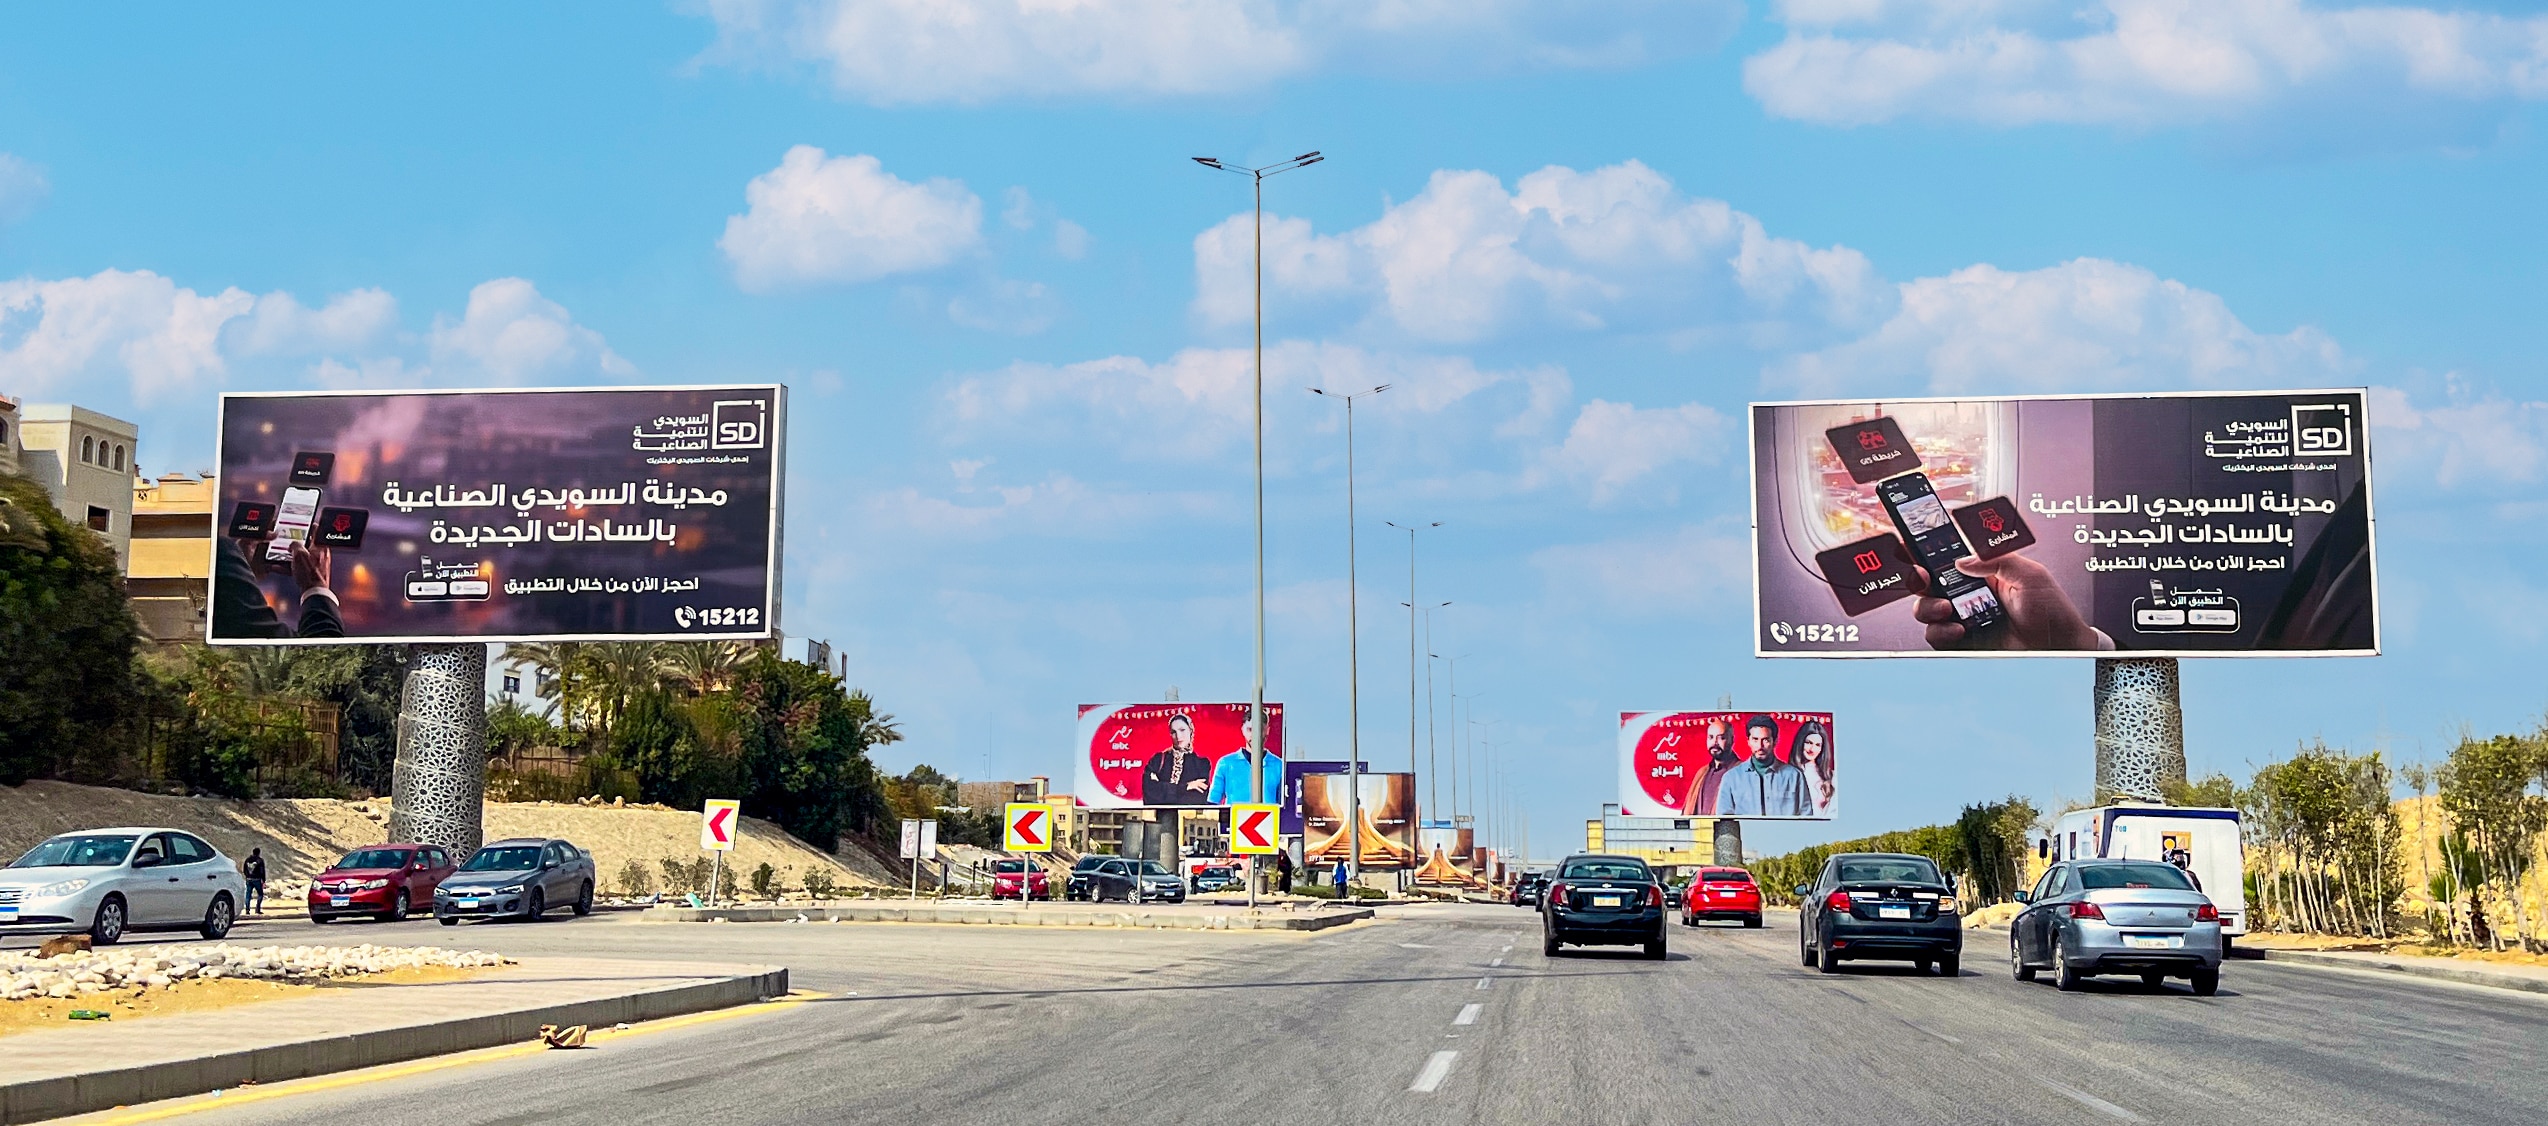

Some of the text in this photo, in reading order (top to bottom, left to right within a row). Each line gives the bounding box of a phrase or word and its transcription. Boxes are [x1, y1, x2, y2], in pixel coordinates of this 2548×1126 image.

[653, 413, 709, 430] السويدي
[2225, 418, 2288, 436] السويدي
[633, 425, 709, 439] للتنمية
[720, 422, 757, 442] SD
[2205, 431, 2289, 446] للتنمية
[2301, 427, 2344, 449] SD
[632, 438, 708, 452] الصناعية
[2205, 445, 2290, 459] الصناعية
[1872, 450, 1902, 462] خريطة
[382, 478, 728, 517] مدينة السويدي الصناعية
[2029, 489, 2336, 523] مدينة السويدي الصناعية
[430, 518, 677, 548] بالسادات الجديدة
[1988, 530, 2019, 548] المشاريع
[2073, 523, 2294, 549] بالسادات الجديدة
[2085, 554, 2285, 572] احجز الآن من خلال التطبيق
[504, 576, 699, 595] احجز الآن من خلال التطبيق
[1879, 573, 1902, 590] احجز
[2188, 596, 2224, 607] التطبيق
[698, 607, 760, 626] 15212
[1796, 623, 1860, 642] 15212
[1099, 757, 1143, 771] سوا سوا
[1657, 751, 1678, 761] mbc
